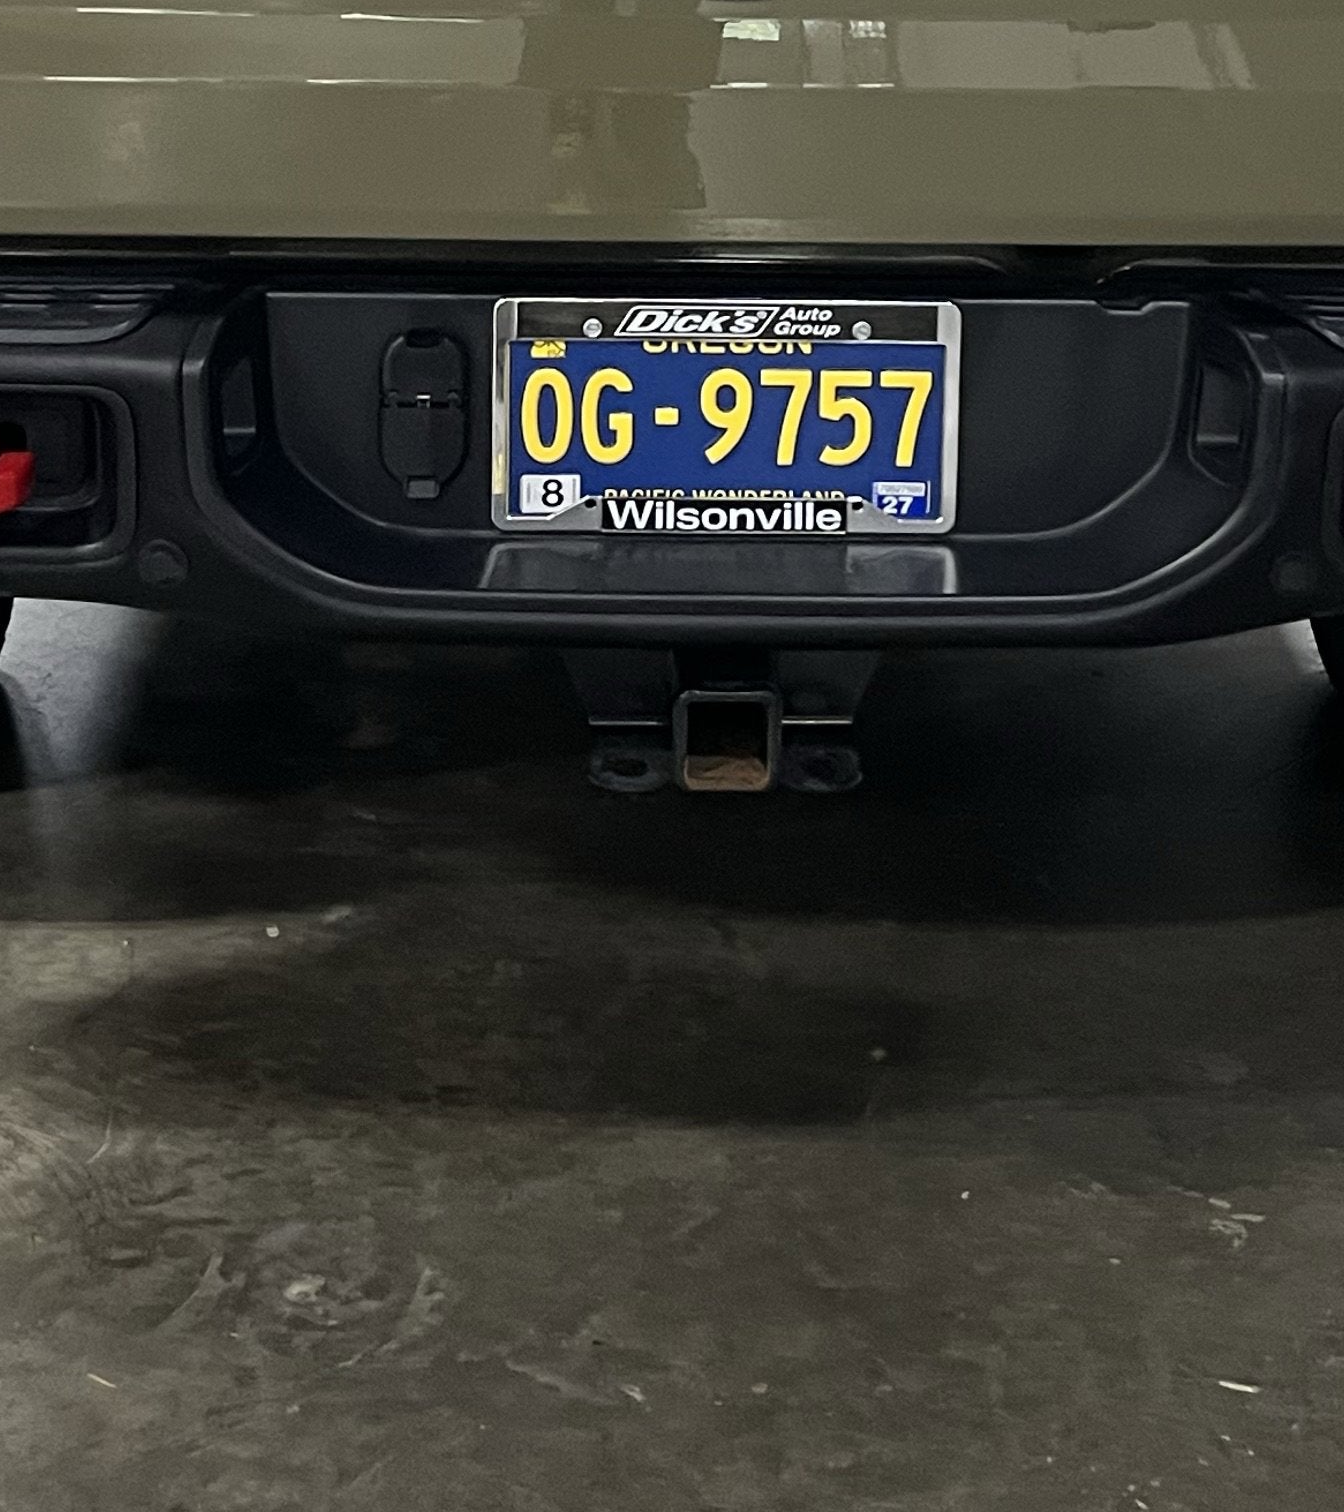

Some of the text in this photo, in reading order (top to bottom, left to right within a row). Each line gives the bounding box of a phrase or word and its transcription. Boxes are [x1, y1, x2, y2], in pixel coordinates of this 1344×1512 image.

[625, 308, 759, 334] Dick's
[779, 306, 834, 322] Auto
[773, 321, 842, 338] Group
[541, 478, 565, 508] 8
[607, 499, 843, 531] Wilsonville
[882, 495, 914, 516] 27
